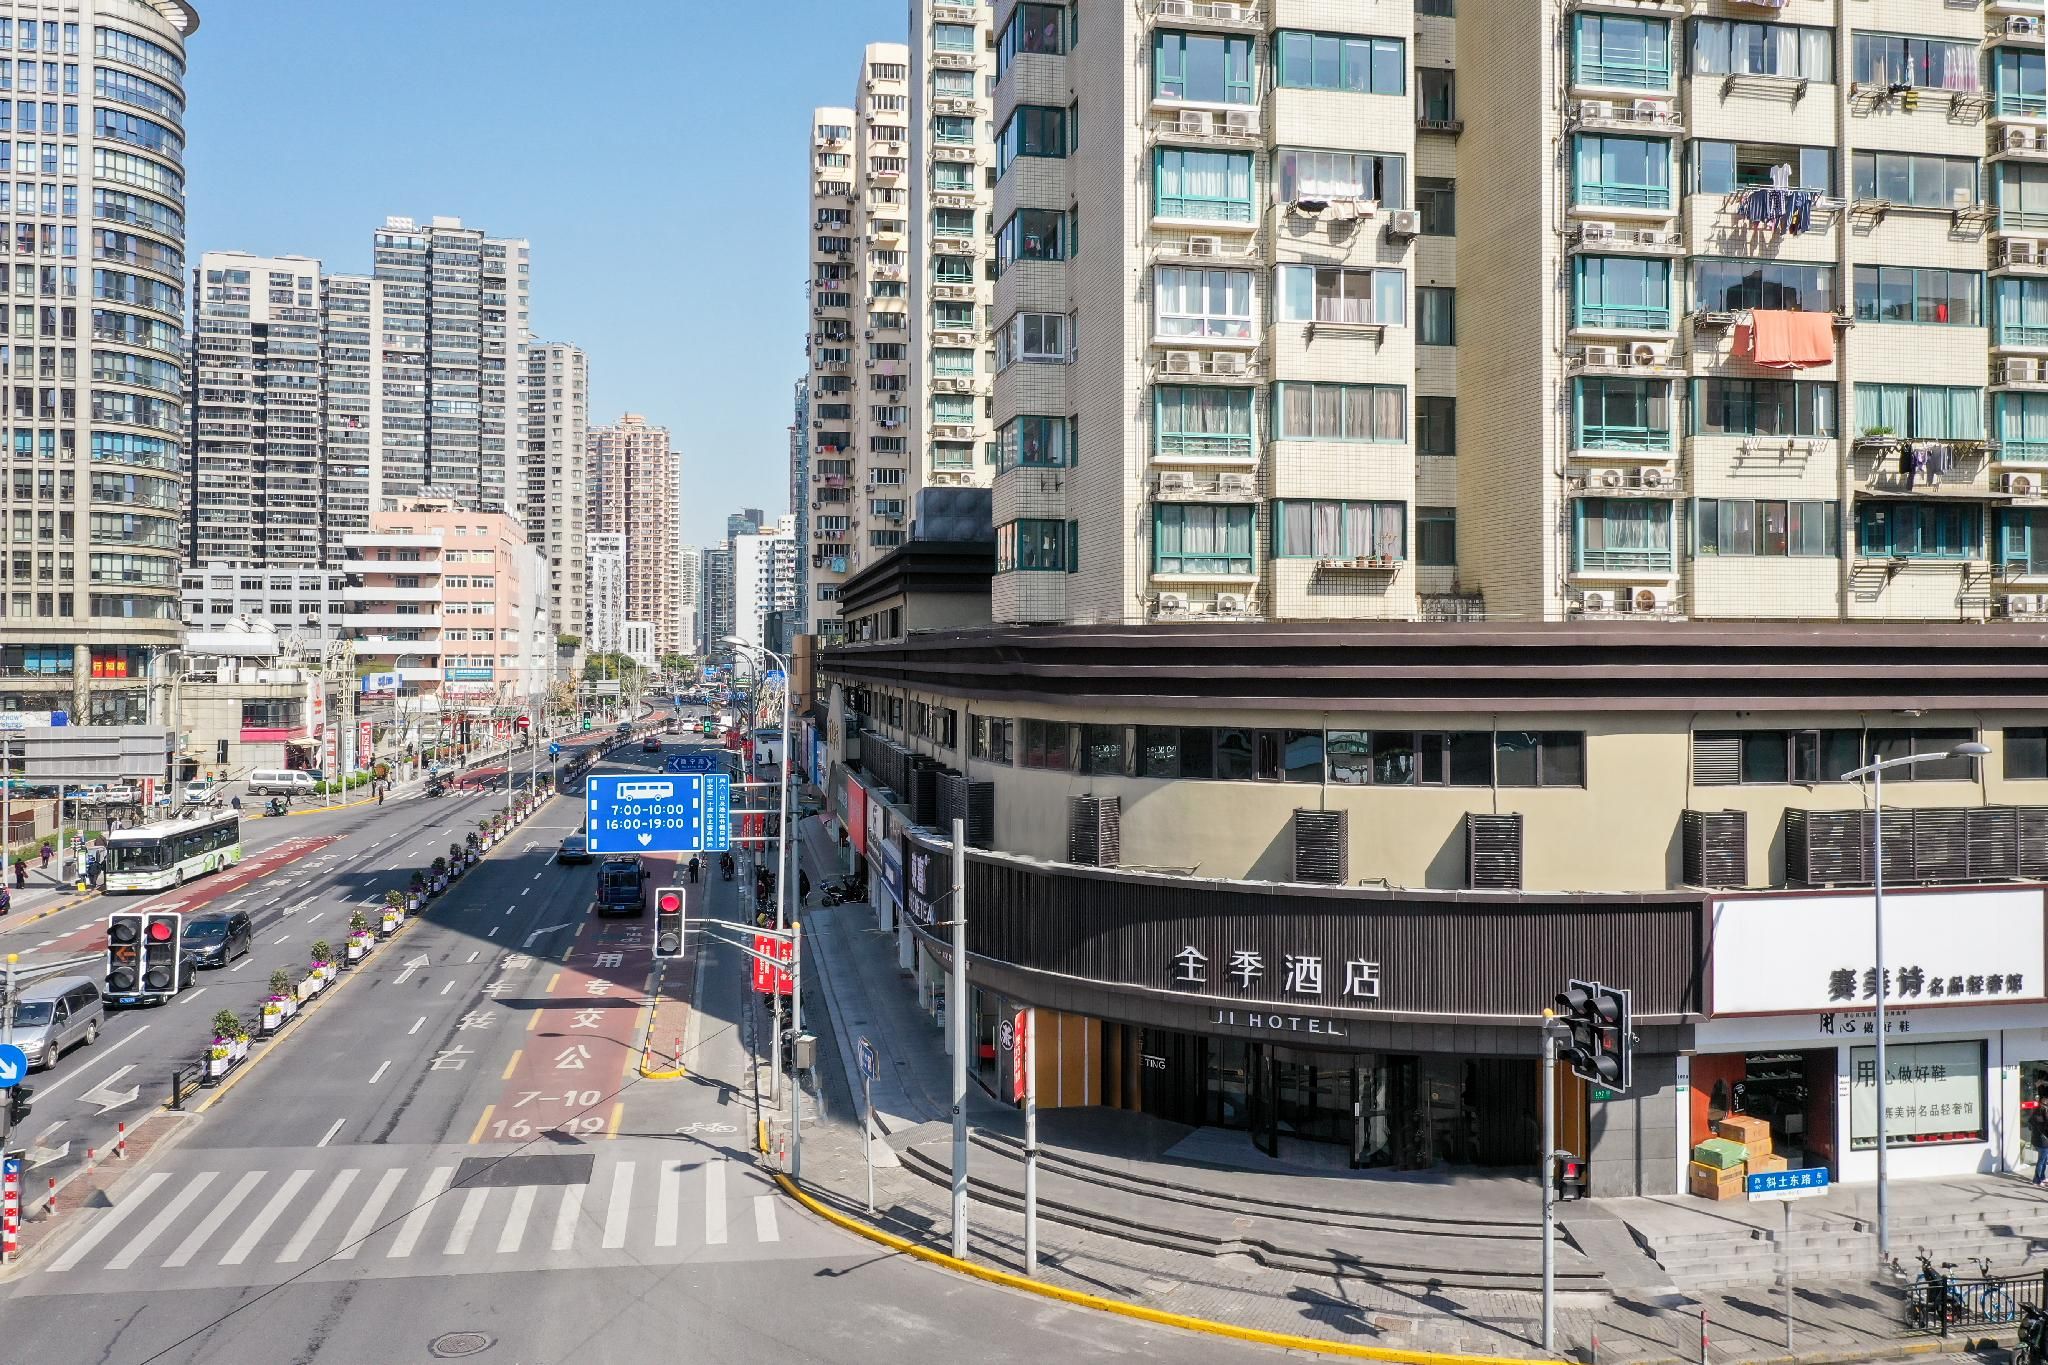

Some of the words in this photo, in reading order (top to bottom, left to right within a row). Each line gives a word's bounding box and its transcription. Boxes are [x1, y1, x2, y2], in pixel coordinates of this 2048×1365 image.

[610, 804, 684, 816] 7:00-10:00
[606, 818, 684, 830] 16:00-19:00
[1174, 945, 1380, 998] 全季酒店
[1210, 1010, 1234, 1025] JI
[1249, 1013, 1346, 1036] HOTEL
[1855, 1060, 1947, 1089] 用心做好鞋
[1765, 1173, 1812, 1189] 斜土东路
